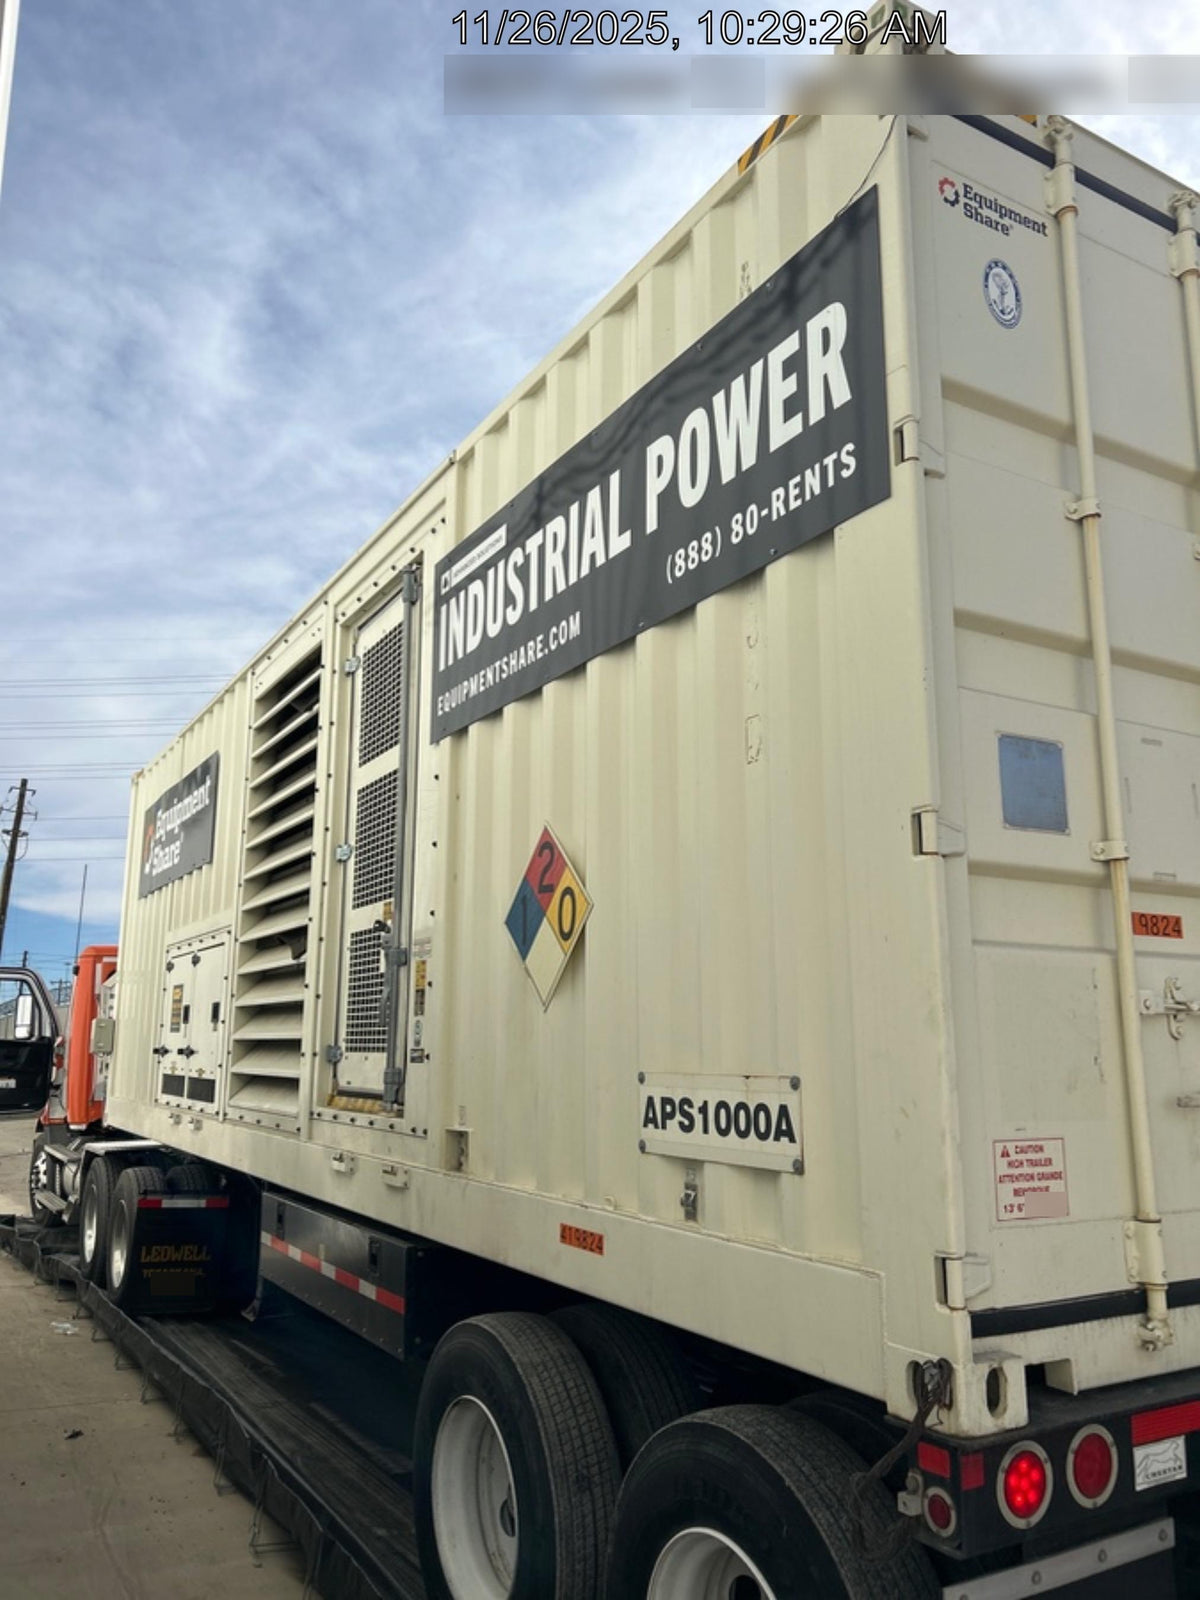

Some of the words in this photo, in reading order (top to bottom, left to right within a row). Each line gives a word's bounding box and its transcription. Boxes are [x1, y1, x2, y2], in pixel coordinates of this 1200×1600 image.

[963, 183, 1048, 237] Equipment
[439, 469, 632, 672] INDUSTRIAL
[646, 302, 853, 535] POWER
[666, 525, 721, 584] (888)
[731, 442, 857, 545] 80-RENTS
[437, 611, 581, 717] EQUIPMENTSHARE.COM
[156, 775, 211, 841] Equipment
[538, 842, 555, 894] 2
[521, 895, 528, 948] 1
[557, 886, 577, 942] 0
[643, 1095, 797, 1144] APS1000A
[141, 1245, 210, 1263] LEDWELL
